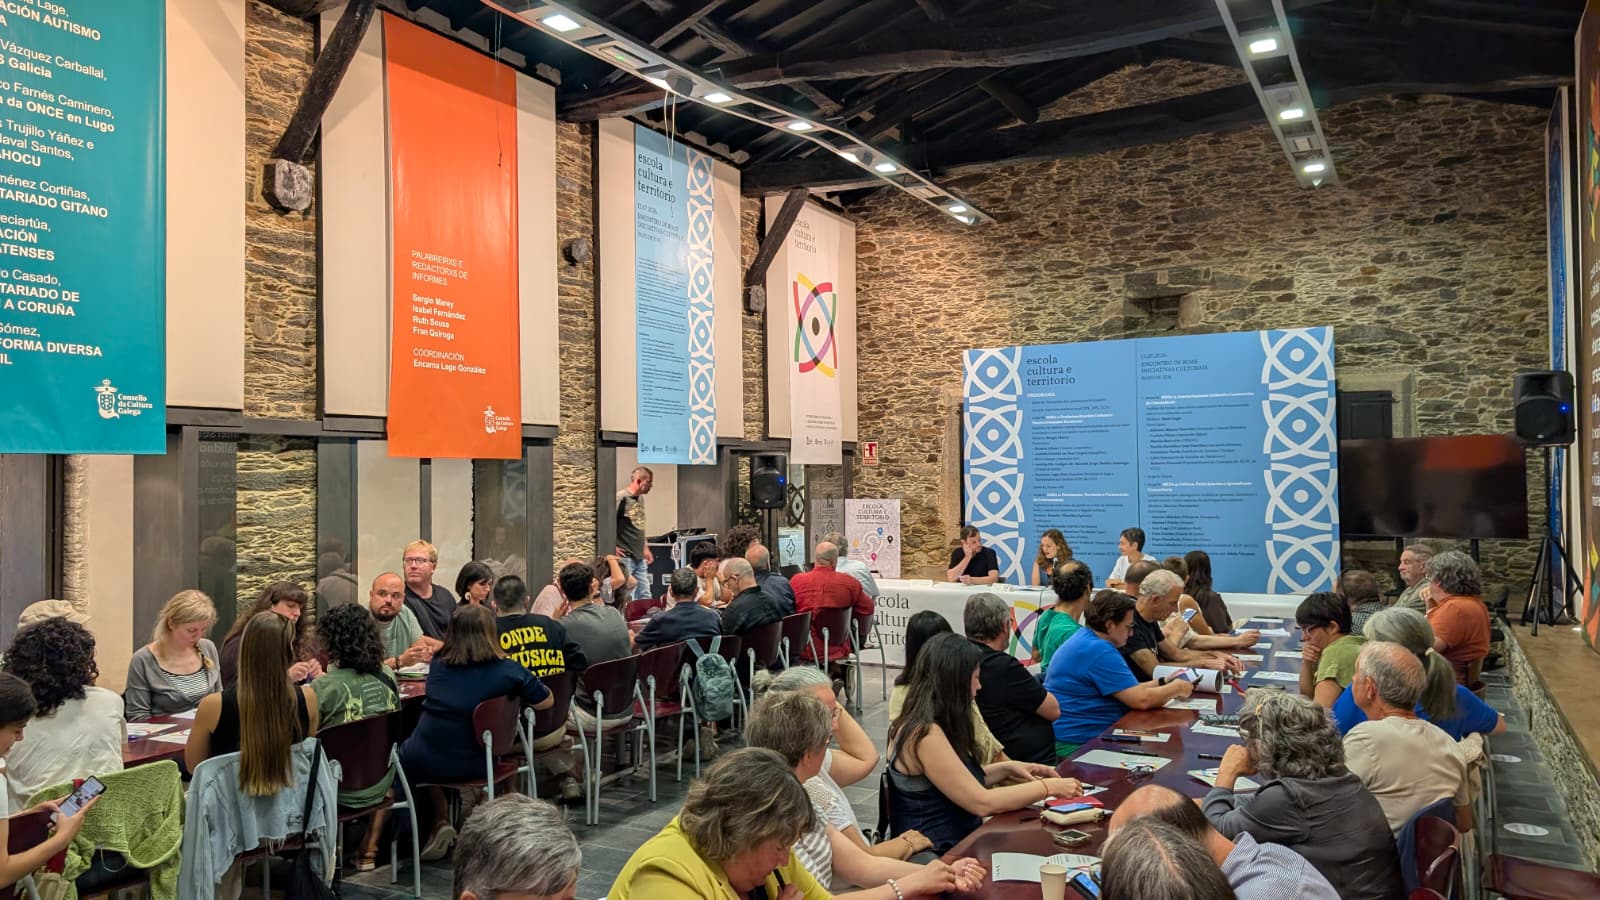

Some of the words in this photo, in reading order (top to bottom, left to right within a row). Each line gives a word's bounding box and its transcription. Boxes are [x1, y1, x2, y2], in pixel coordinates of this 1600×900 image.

[43, 14, 102, 41] AUTISMO
[0, 39, 52, 64] Vázquez
[55, 56, 108, 80] Carballal,
[8, 57, 53, 79] Galicia
[14, 82, 55, 102] Farnés
[58, 95, 116, 119] Caminero,
[7, 97, 23, 109] da
[26, 101, 65, 120] ONCE
[67, 115, 82, 125] en
[85, 116, 115, 133] Lugo
[6, 119, 46, 138] Trujillo
[48, 129, 84, 147] Yáñez
[87, 141, 95, 150] e
[0, 132, 28, 150] aval
[31, 140, 75, 161] Santos,
[0, 148, 41, 167] HOCU
[639, 153, 663, 171] escola
[638, 168, 667, 187] cultura
[669, 180, 673, 188] e
[39, 181, 91, 201] Cortiñas,
[638, 181, 676, 203] territorio
[0, 187, 58, 209] TARIADO
[61, 199, 108, 218] GITANO
[0, 242, 55, 261] TENSES
[12, 268, 62, 287] Casado,
[411, 271, 449, 287] INFORMES
[0, 281, 59, 300] TARIADO
[62, 289, 81, 303] DE
[412, 293, 434, 305] Sergio
[4, 298, 15, 311] A
[17, 299, 76, 317] CORUÑA
[412, 304, 433, 315] Isabel
[412, 315, 429, 325] Ruth
[412, 326, 429, 335] Fran
[429, 328, 455, 341] Quiroga
[0, 337, 45, 353] ORMA
[47, 341, 103, 358] DIVERSA
[440, 362, 457, 373] Lago
[1026, 354, 1058, 366] escola
[1026, 365, 1065, 377] cultura
[1065, 366, 1073, 375] e
[1026, 375, 1076, 387] territorio
[118, 393, 148, 402] Consello
[127, 401, 153, 410] Cultura
[118, 408, 142, 416] Galega
[875, 593, 910, 610] cola
[500, 625, 548, 650] ONDE
